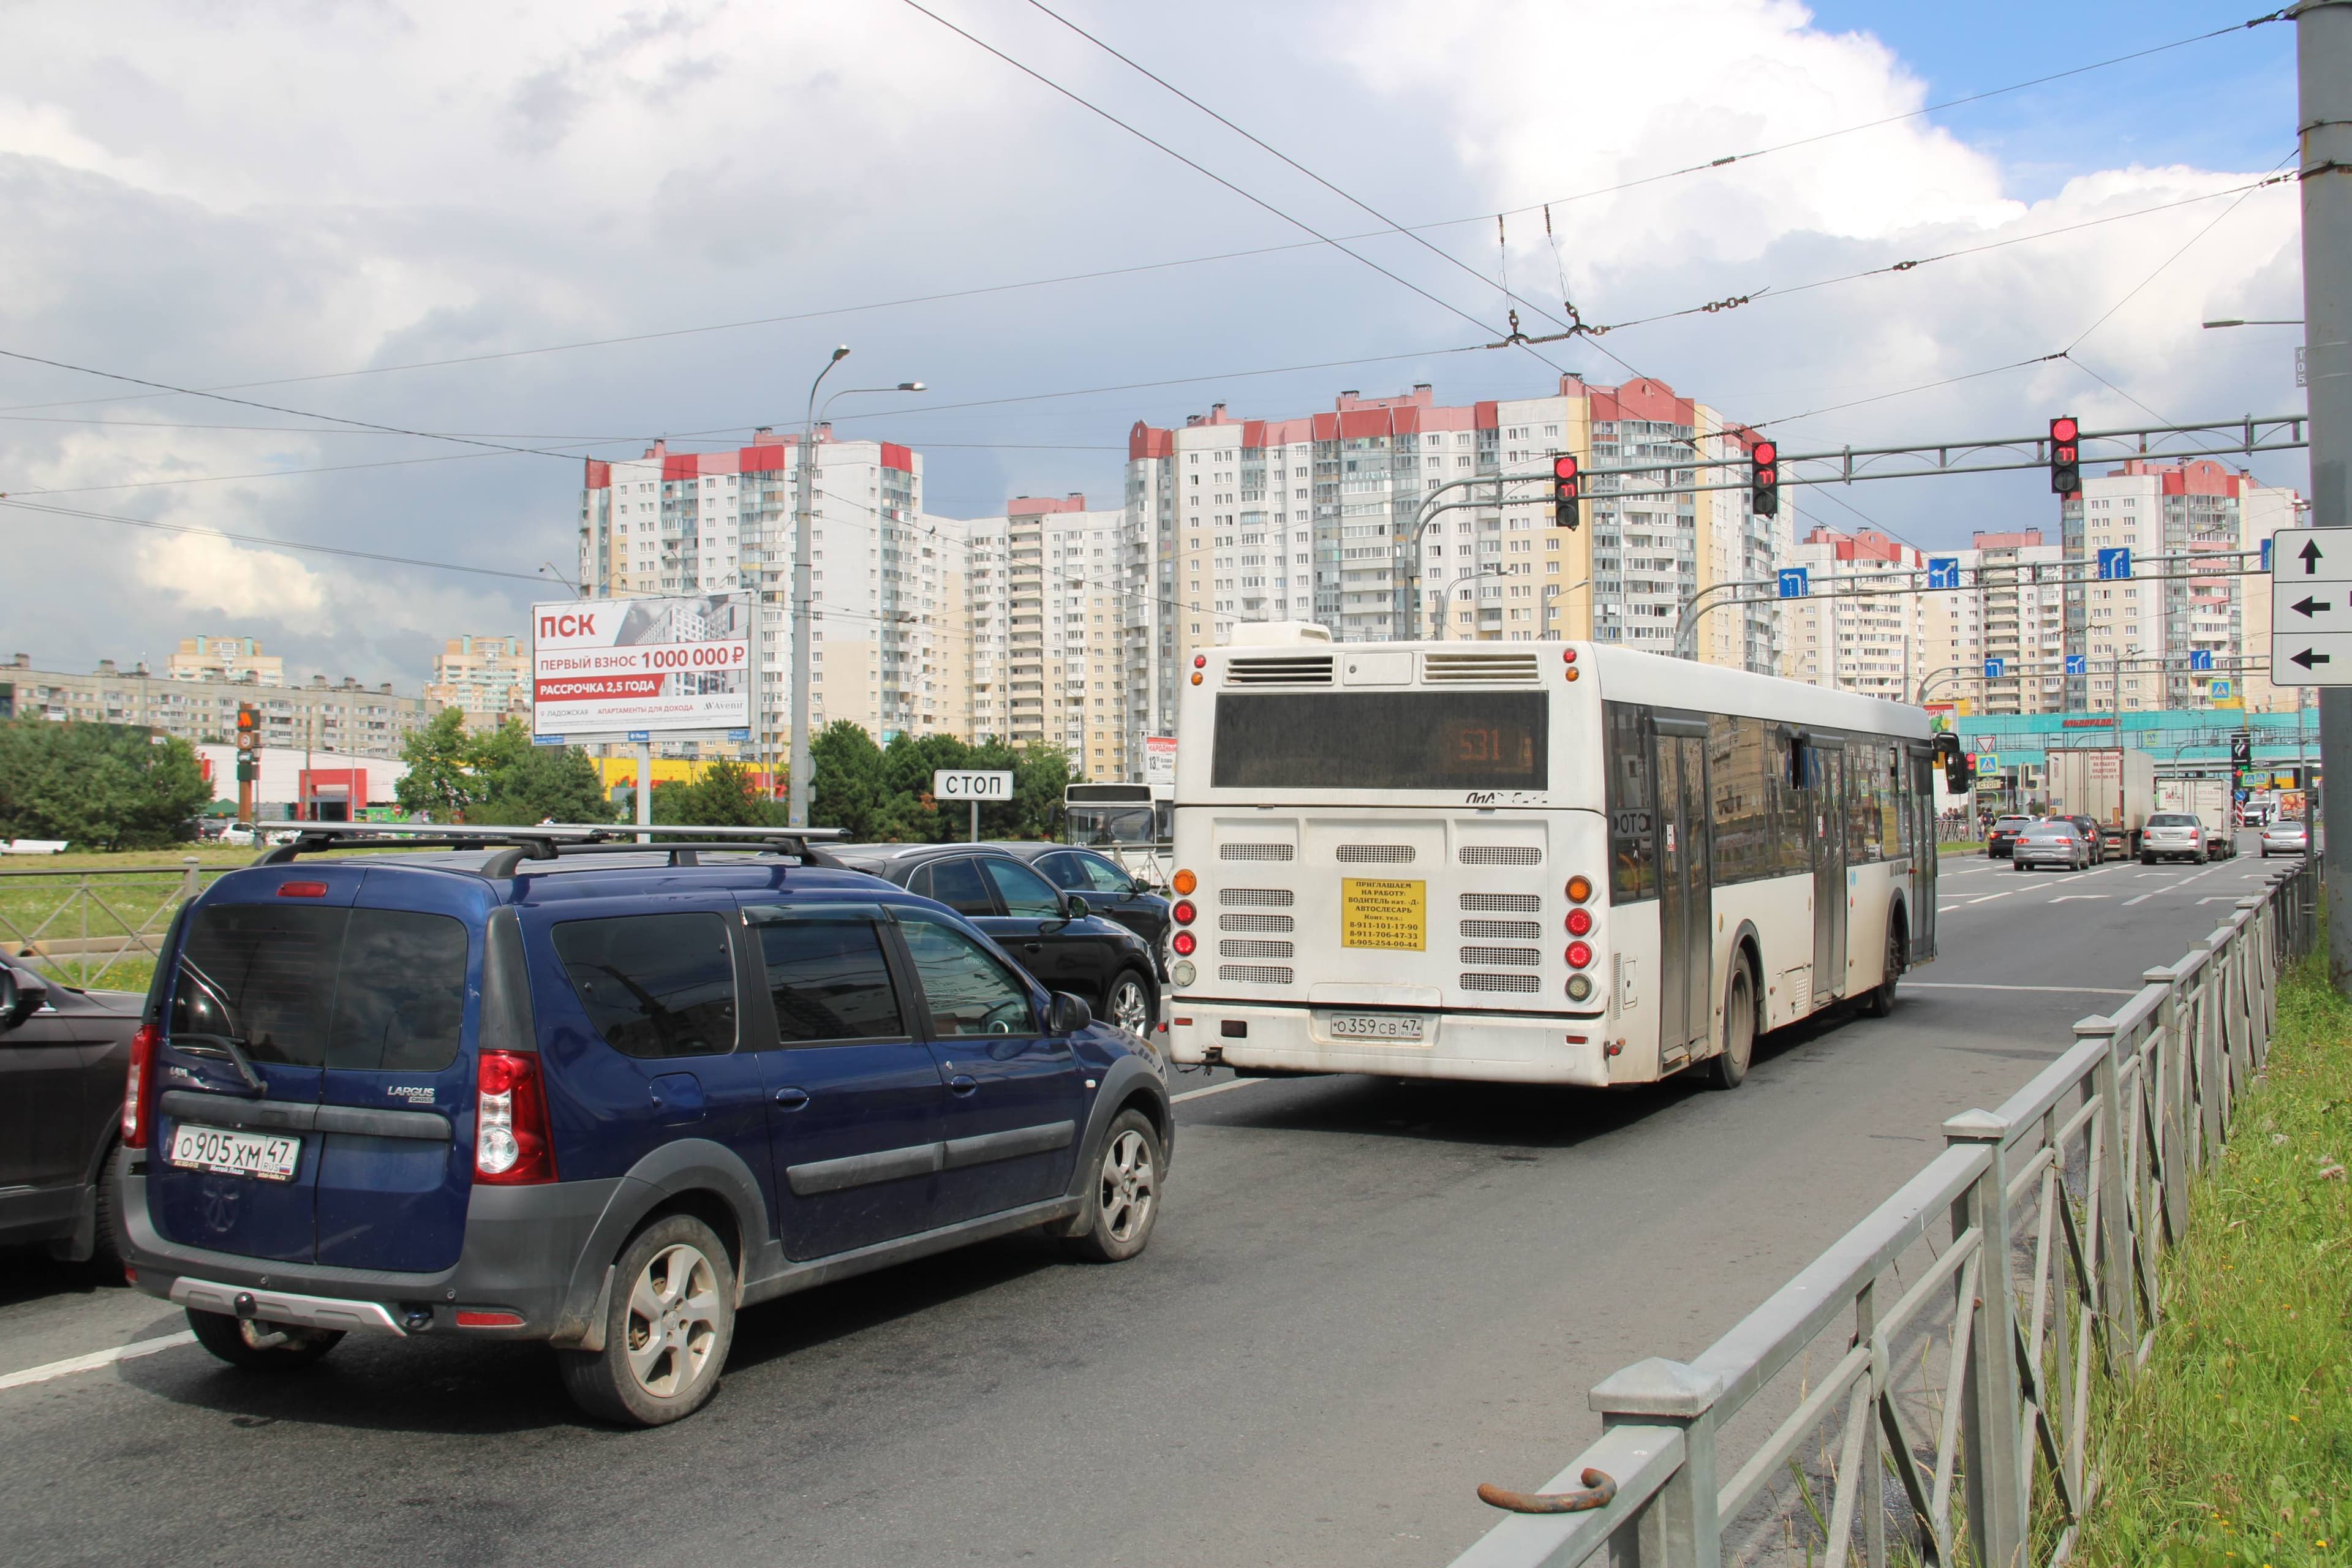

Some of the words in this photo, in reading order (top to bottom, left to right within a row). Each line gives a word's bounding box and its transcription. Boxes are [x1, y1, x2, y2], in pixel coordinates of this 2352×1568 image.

[540, 614, 595, 639] ПСК
[541, 655, 592, 671] ПЕРВЫЙ
[595, 655, 637, 668] ВЗНОС
[540, 682, 604, 695] РАССРОЧКА
[606, 682, 623, 694] 2,5
[625, 680, 655, 693] ГОДА
[598, 706, 647, 715] АПАРТАМЕНТЫ
[664, 704, 694, 713] ДОХОДА
[714, 702, 744, 710] Avenir
[1460, 729, 1500, 760] 531
[946, 776, 1001, 794] СТОП
[1350, 930, 1417, 939] 8-911-706-47-33
[387, 1086, 435, 1096] LARGUS
[268, 1140, 290, 1163] 47
[263, 1162, 279, 1172] RUS
